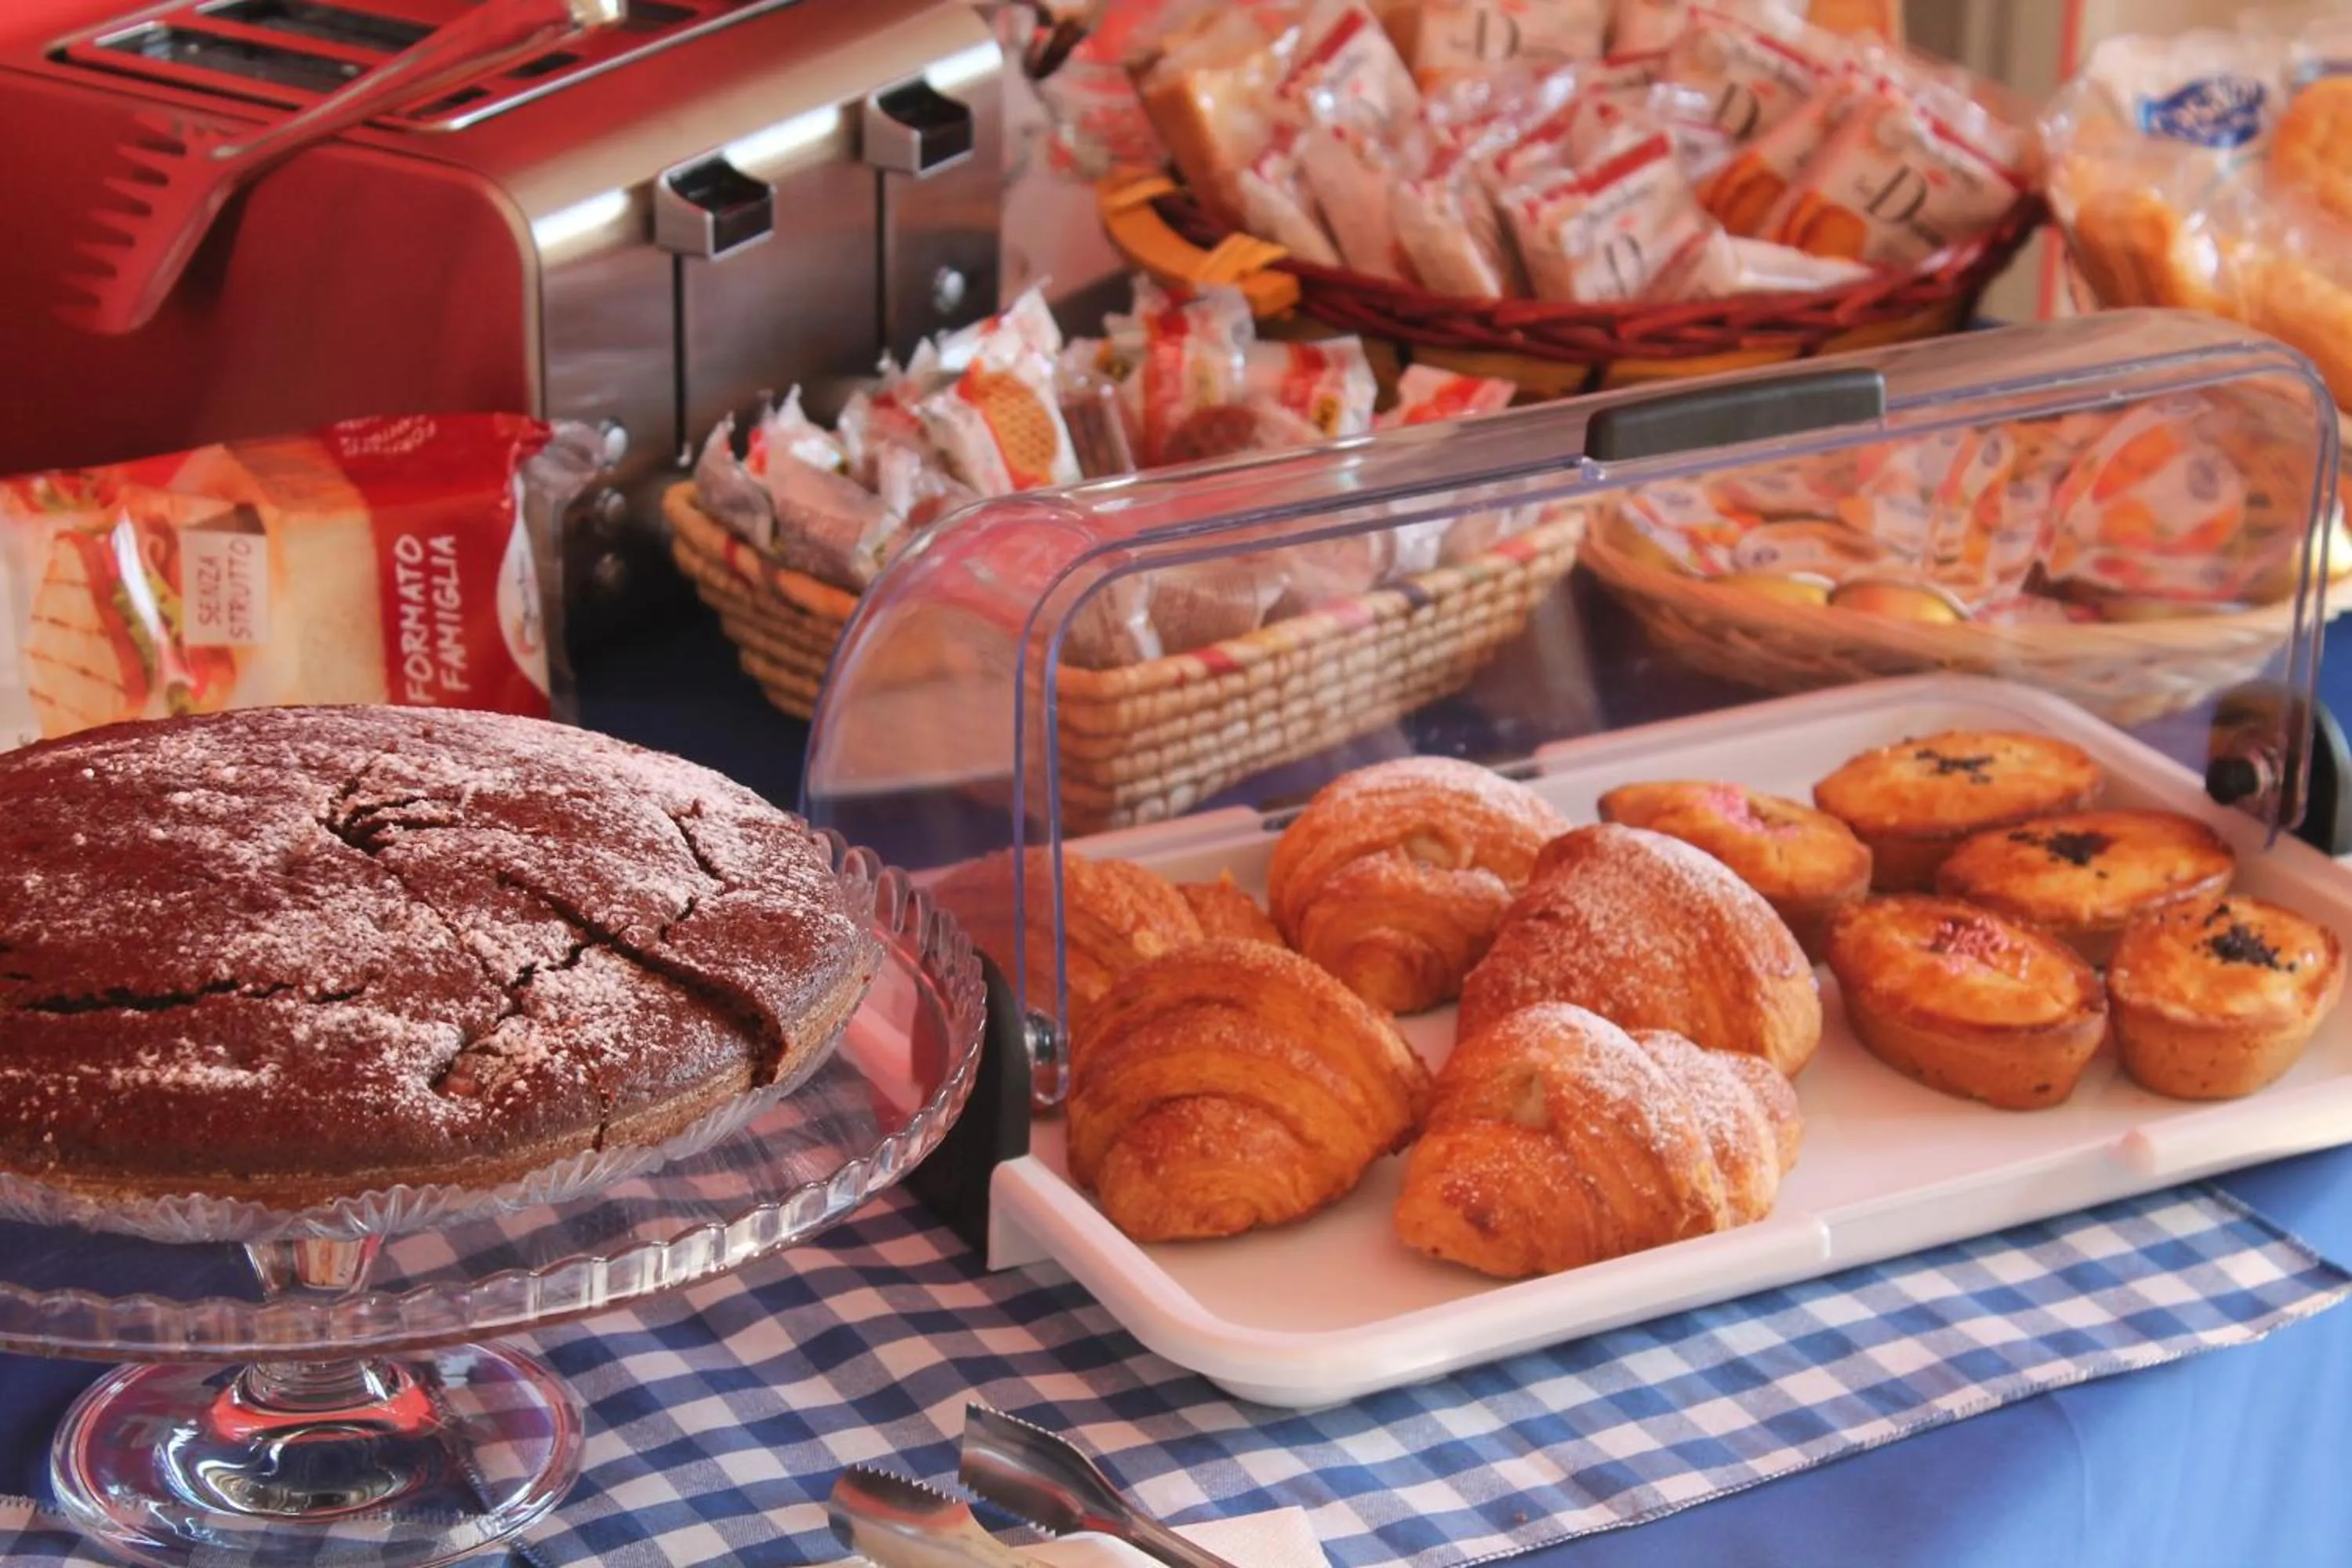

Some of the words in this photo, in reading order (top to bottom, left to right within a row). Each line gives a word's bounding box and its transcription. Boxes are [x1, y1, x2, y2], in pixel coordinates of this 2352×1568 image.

[196, 555, 222, 626] SENZA
[227, 537, 253, 640] STRUTTO
[394, 535, 437, 705] FORMATO
[429, 535, 469, 691] FAMIGLIA
